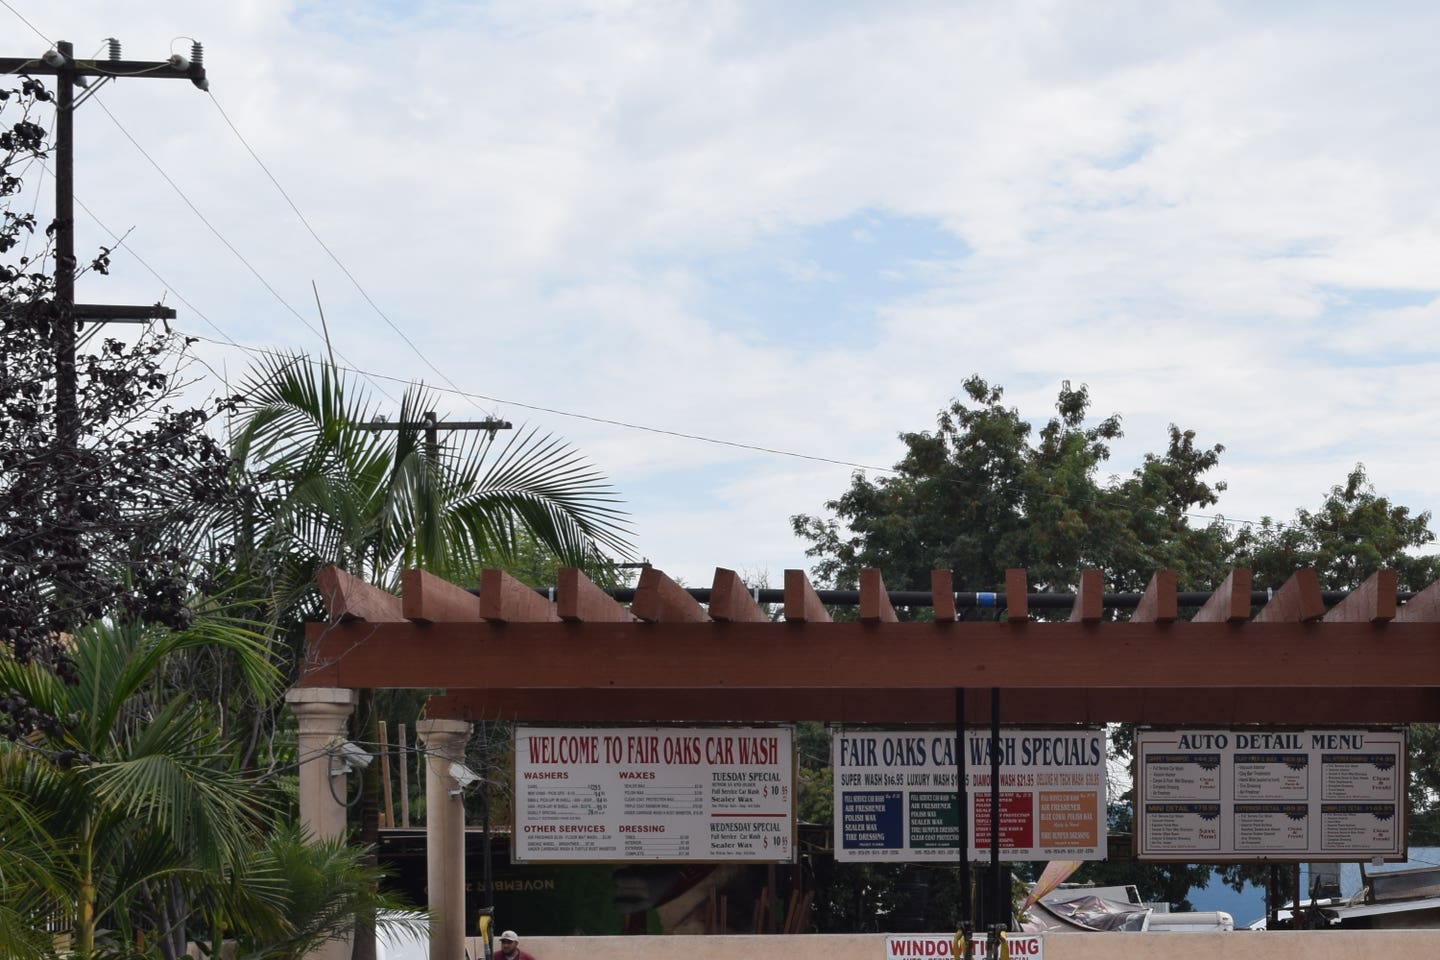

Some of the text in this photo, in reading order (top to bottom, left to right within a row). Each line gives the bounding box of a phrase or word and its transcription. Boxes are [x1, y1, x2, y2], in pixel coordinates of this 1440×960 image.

[1178, 734, 1364, 750] AUTO DETAIL MENU
[528, 736, 778, 765] WELCOME TO FAIR OAKS CAR WASH
[840, 738, 878, 766] FAIR
[882, 738, 927, 766] OAKS
[1022, 738, 1100, 766] SPECIALS
[524, 772, 569, 780] WASHERS
[619, 772, 656, 780] WAXES
[712, 772, 781, 782] TUESDAY SPECIAL
[841, 774, 904, 786] SUPER WASH $16.95
[907, 774, 930, 786] LUXURY
[933, 774, 950, 786] WASH
[973, 774, 993, 786] DIAMO
[1000, 774, 1016, 786] WASH
[710, 823, 781, 832] WEDNESDAY SPECIAL
[478, 880, 554, 891] NOVEMBR
